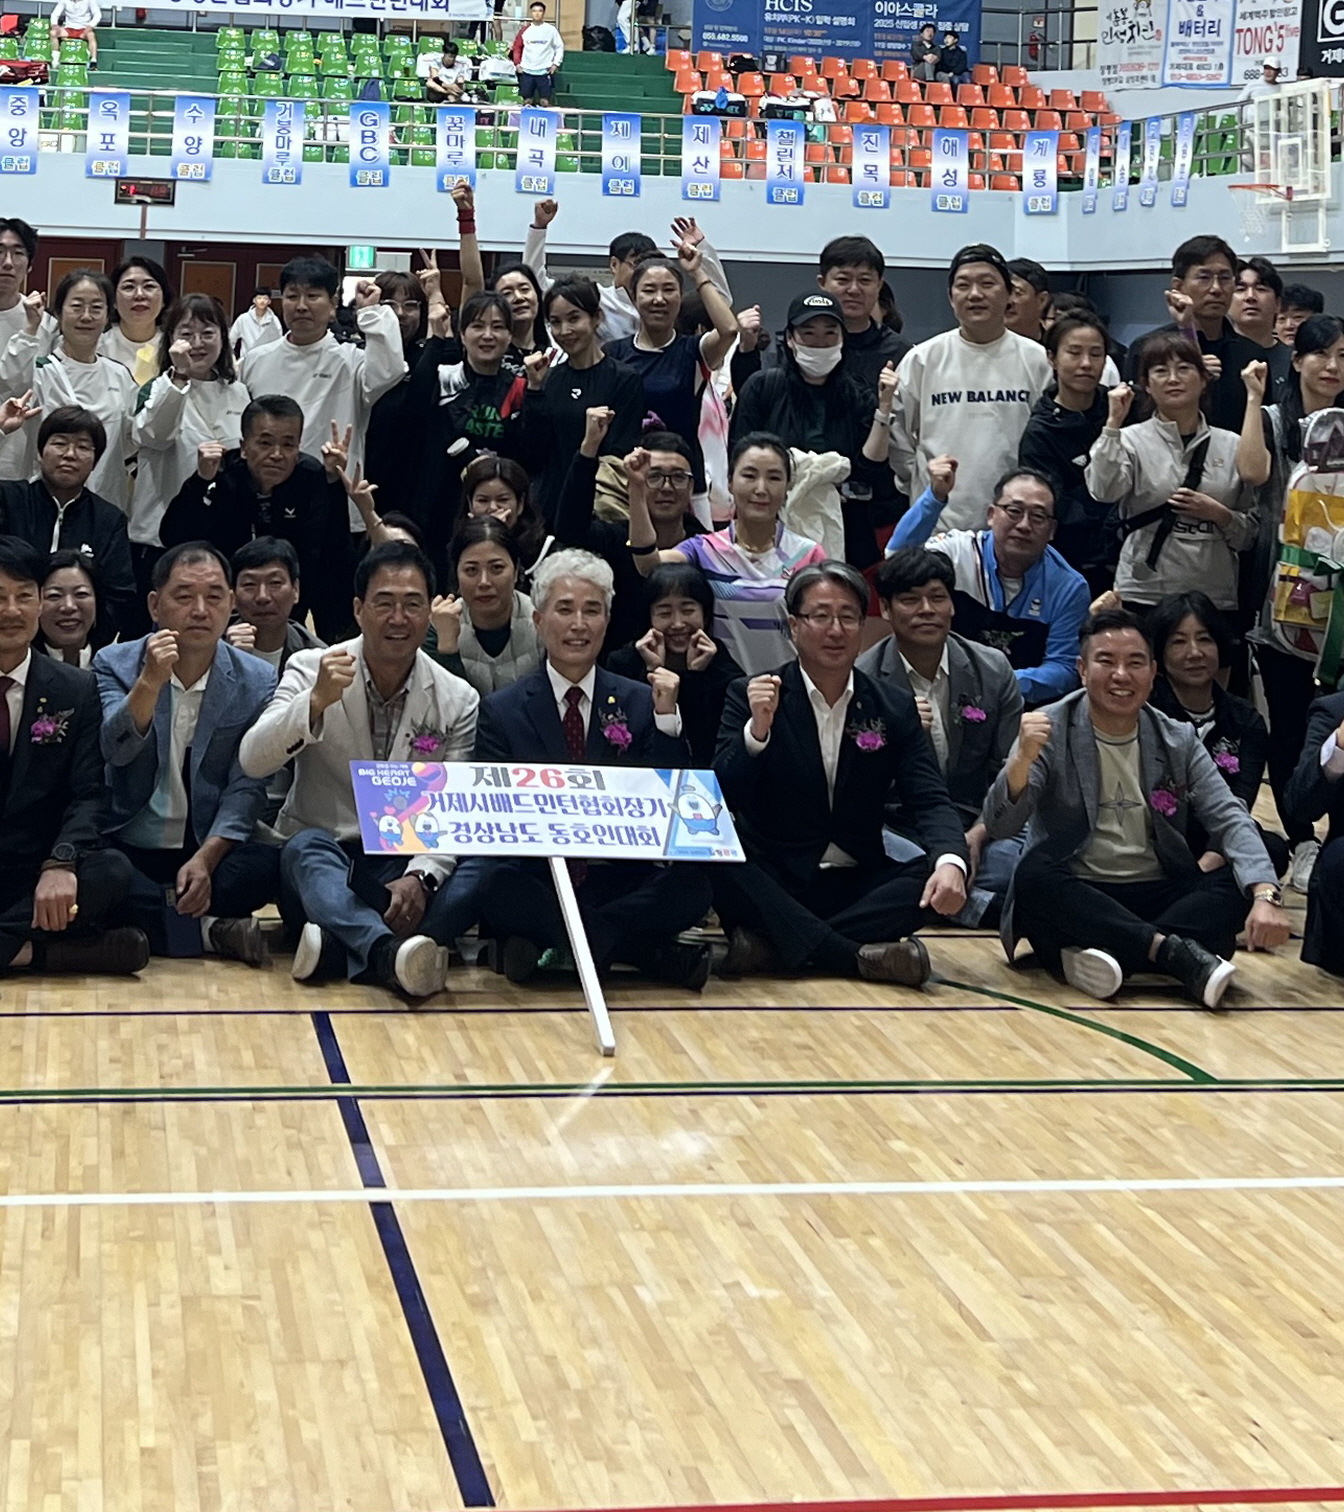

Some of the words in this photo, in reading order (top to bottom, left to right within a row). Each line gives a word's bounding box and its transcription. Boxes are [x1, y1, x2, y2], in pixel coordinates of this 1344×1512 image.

[1196, 5, 1204, 17] &
[1179, 19, 1221, 38] 배터리
[8, 95, 28, 148] 중앙
[99, 100, 119, 153] 옥포
[183, 103, 204, 157] 수양
[359, 112, 379, 164] GBC
[527, 117, 548, 167] 내곡
[610, 120, 631, 173] 제이
[691, 123, 710, 174] 제산
[1, 155, 30, 171] 클럽
[862, 133, 880, 182] 진목
[942, 137, 957, 187] 해성
[91, 160, 120, 176] 클럽
[177, 162, 205, 178] 클럽
[267, 167, 296, 183] 클럽
[356, 170, 383, 185] 클럽
[521, 175, 548, 191] 클럽
[608, 179, 633, 195] 클럽
[687, 182, 713, 198] 클럽
[772, 187, 799, 202] 클럽
[858, 191, 884, 207] 클럽
[936, 194, 962, 210] 클럽
[1028, 195, 1052, 211] 클럽
[931, 391, 962, 406] NEW
[967, 389, 1030, 403] BALANC
[358, 768, 375, 776] BIG
[470, 766, 606, 791] 제26회
[372, 776, 417, 786] GEOJE
[421, 790, 667, 818] 거제시배드민턴협회장기
[448, 821, 543, 844] 경상남도
[548, 822, 662, 846] 동호인대회
